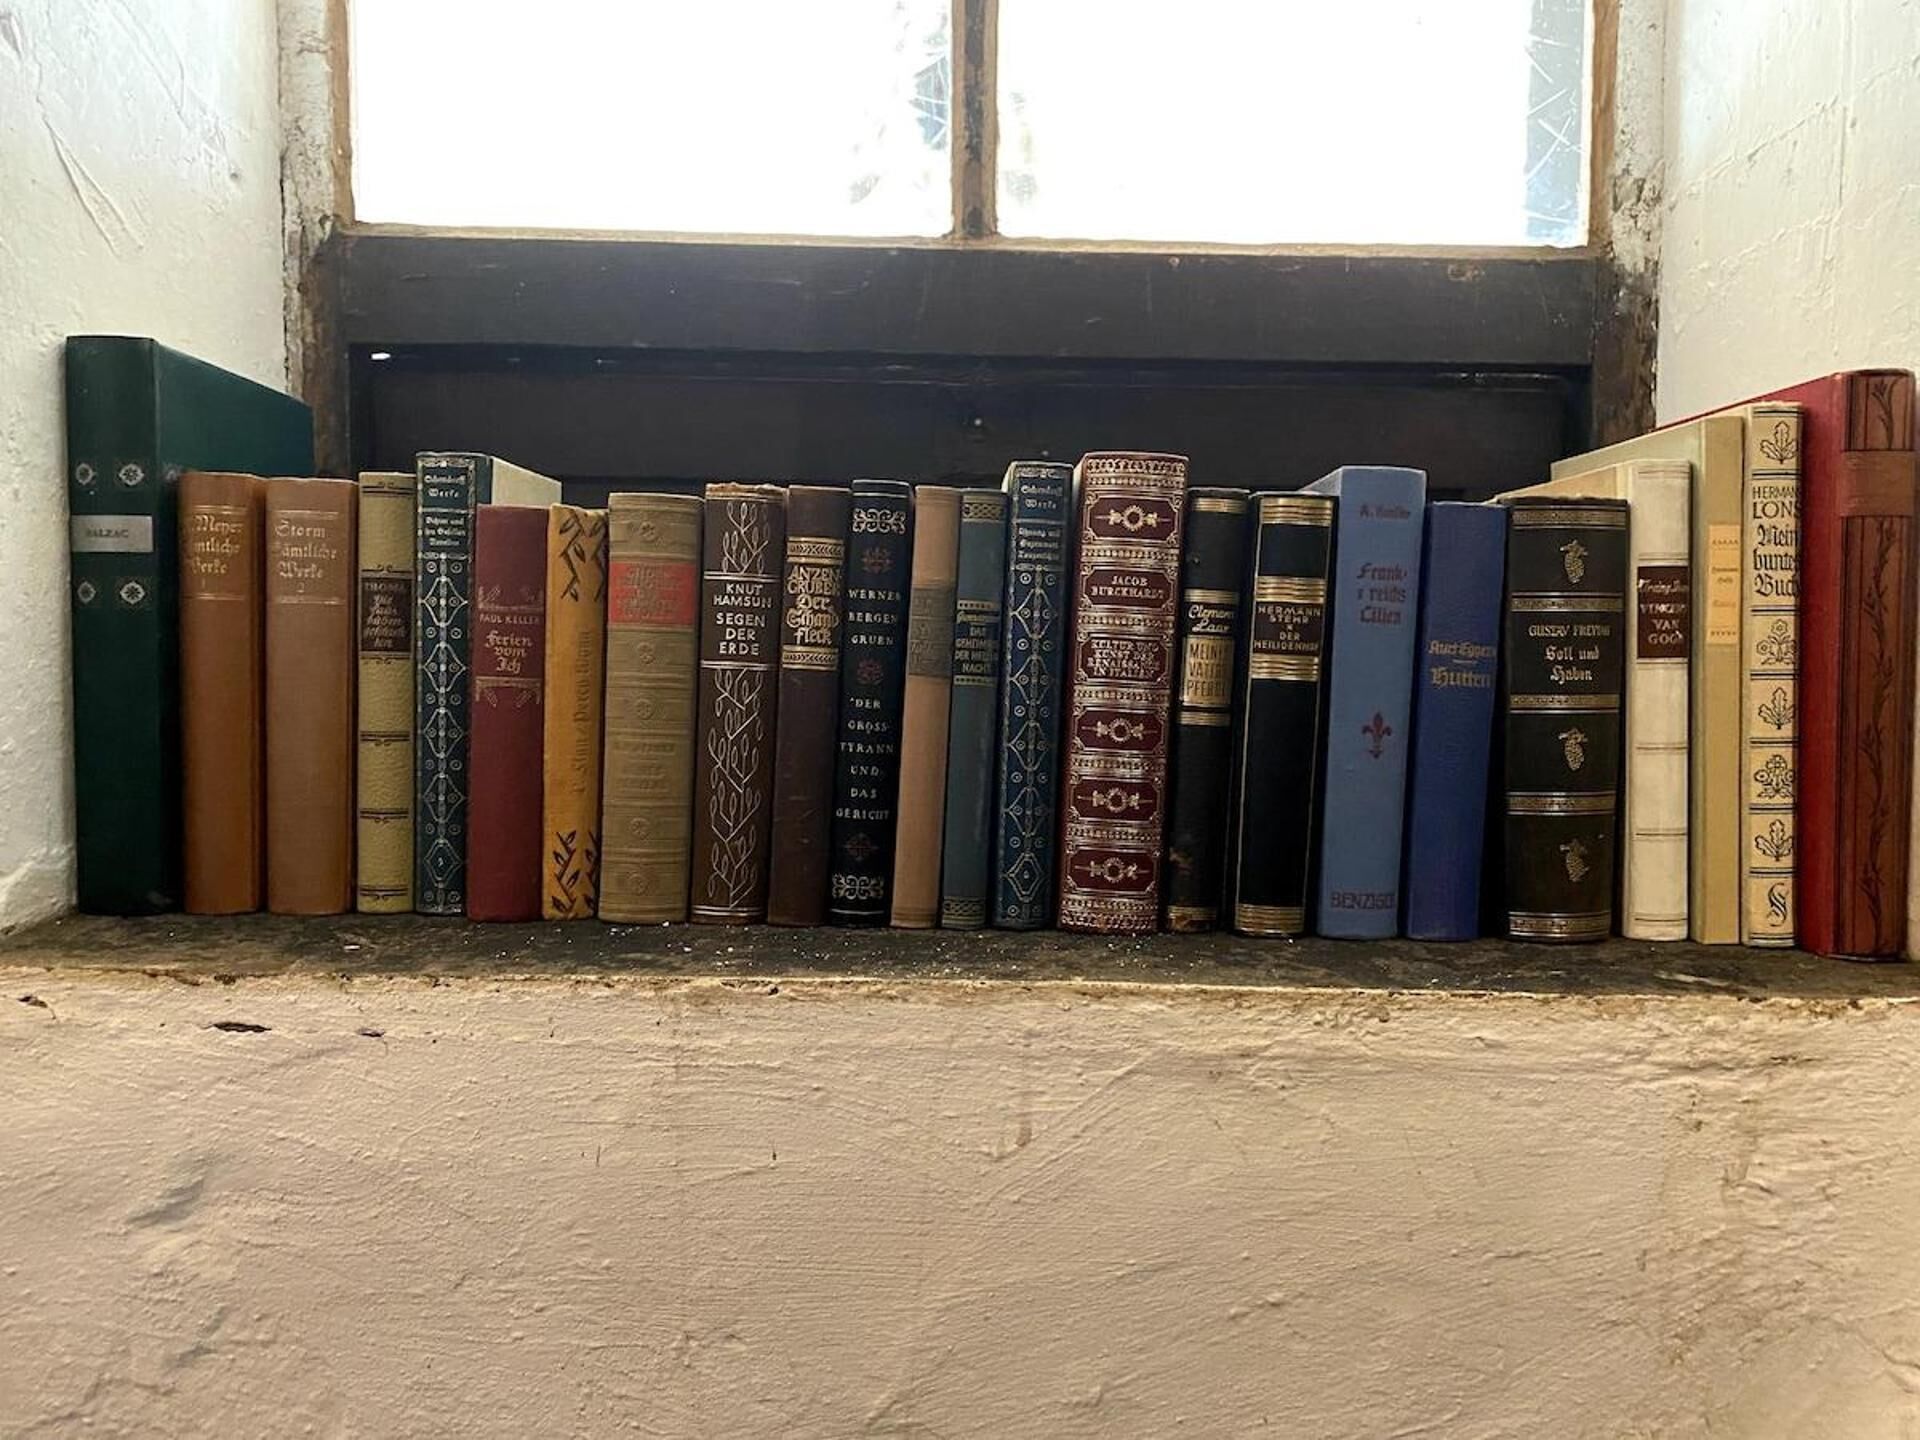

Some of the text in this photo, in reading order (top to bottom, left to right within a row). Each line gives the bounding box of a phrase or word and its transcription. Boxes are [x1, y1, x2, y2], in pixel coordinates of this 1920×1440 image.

[275, 519, 326, 538] Storm
[279, 561, 323, 578] Werke
[1111, 575, 1148, 586] JACOB
[726, 583, 764, 596] KNUT
[713, 594, 772, 608] HAMSUN
[1258, 605, 1321, 616] HERMANN
[479, 613, 540, 625] PAUL KELLER
[716, 612, 766, 627] SEGEN
[1269, 614, 1309, 624] STEHR
[1651, 618, 1680, 630] VAN
[725, 627, 756, 641] DER
[1279, 631, 1300, 641] DER
[1528, 624, 1570, 637] GUSTAV
[484, 630, 533, 648] Ferien
[851, 634, 894, 646] GRUEN
[1090, 639, 1135, 650] KULTUR
[493, 645, 528, 658] vom
[719, 641, 760, 656] ERDE
[1094, 649, 1131, 659] KUNST
[1544, 644, 1600, 660] Soll und
[496, 656, 521, 674] Ich
[1550, 664, 1593, 685] Haben
[855, 698, 881, 708] DER
[840, 742, 894, 754] TYRANN
[850, 765, 879, 777] UND
[850, 787, 877, 799] DAS
[836, 807, 889, 820] GERICHT
